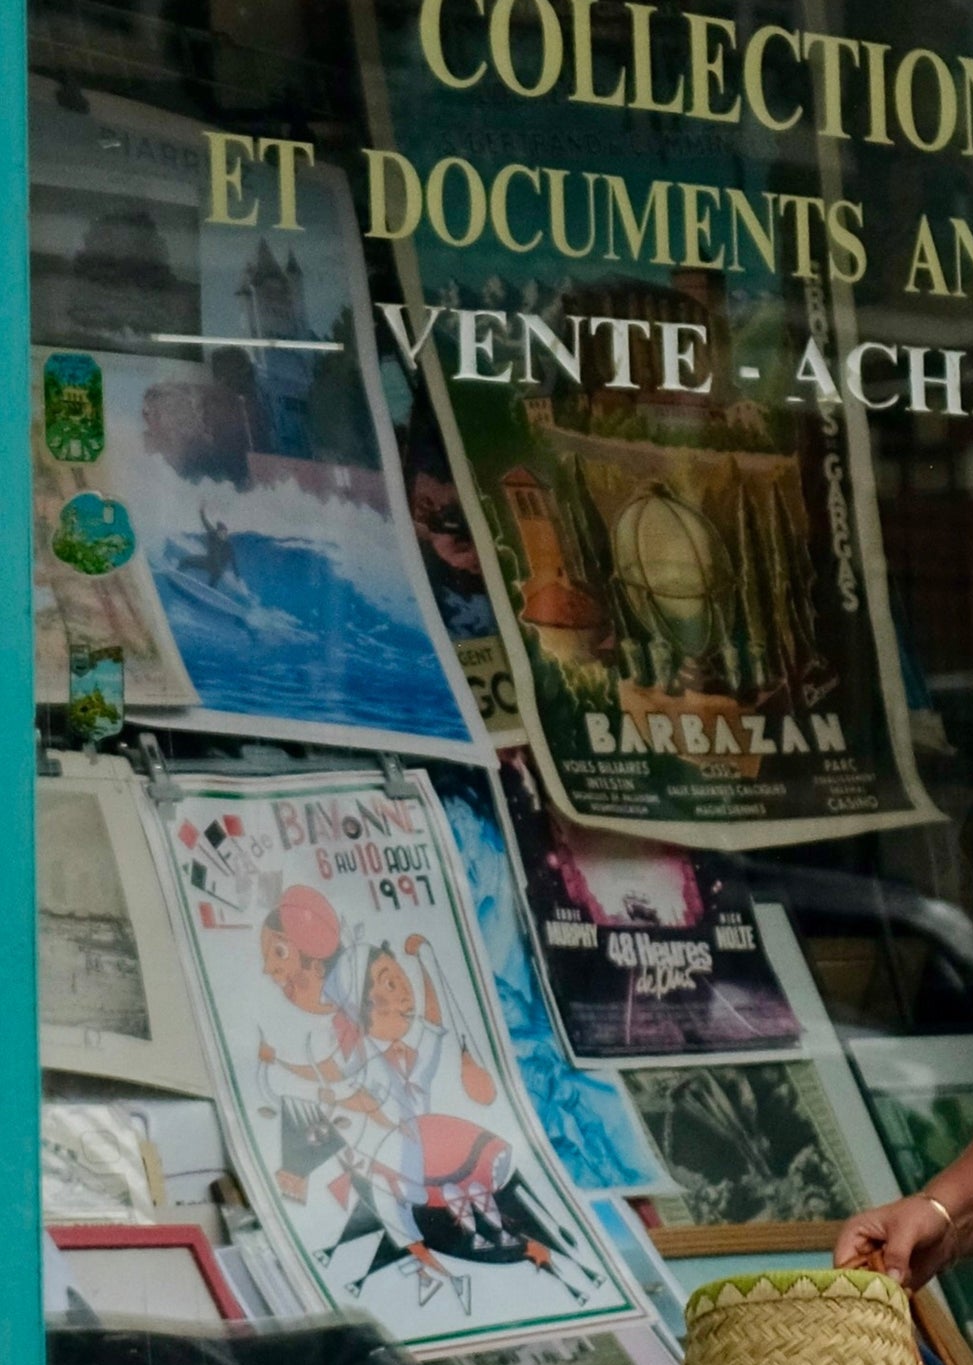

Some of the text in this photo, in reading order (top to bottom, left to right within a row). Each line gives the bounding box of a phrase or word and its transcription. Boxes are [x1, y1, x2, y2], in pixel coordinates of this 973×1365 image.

[204, 130, 315, 230] ET
[363, 148, 868, 284] DOCUMENTS
[377, 303, 713, 394] VENTE
[585, 712, 847, 755] BARBAZAN
[824, 757, 857, 772] PARC
[271, 797, 425, 851] BAYONNE
[315, 846, 334, 881] 6
[335, 850, 358, 874] AU
[356, 840, 383, 876] 10
[368, 875, 435, 912] 1997
[545, 920, 598, 948] MURPHY
[608, 931, 638, 968] 48
[715, 924, 757, 951] NOLTE
